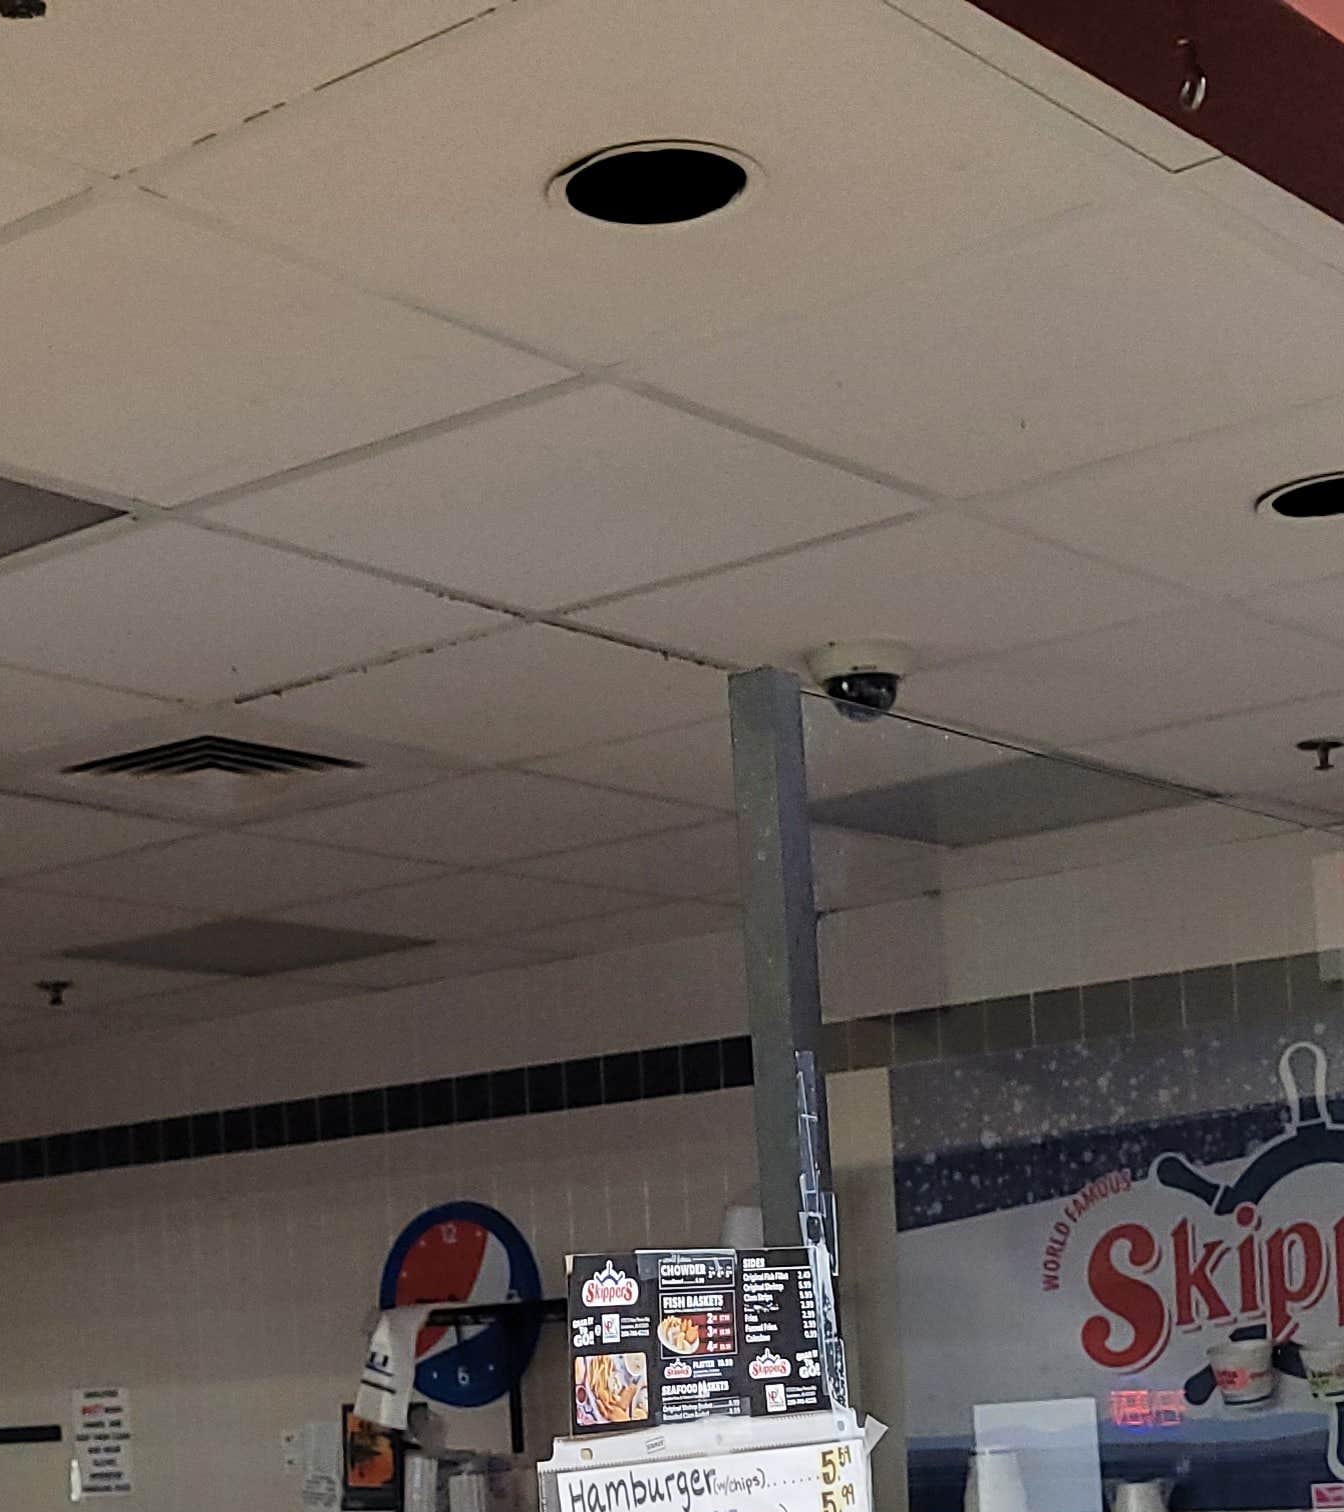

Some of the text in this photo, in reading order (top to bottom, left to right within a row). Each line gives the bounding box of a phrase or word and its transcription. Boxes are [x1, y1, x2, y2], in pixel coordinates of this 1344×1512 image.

[1042, 1168, 1132, 1292] WORLD FAMOUS
[660, 1263, 706, 1277] CHOWDER
[662, 1294, 724, 1309] FISH BASKETS
